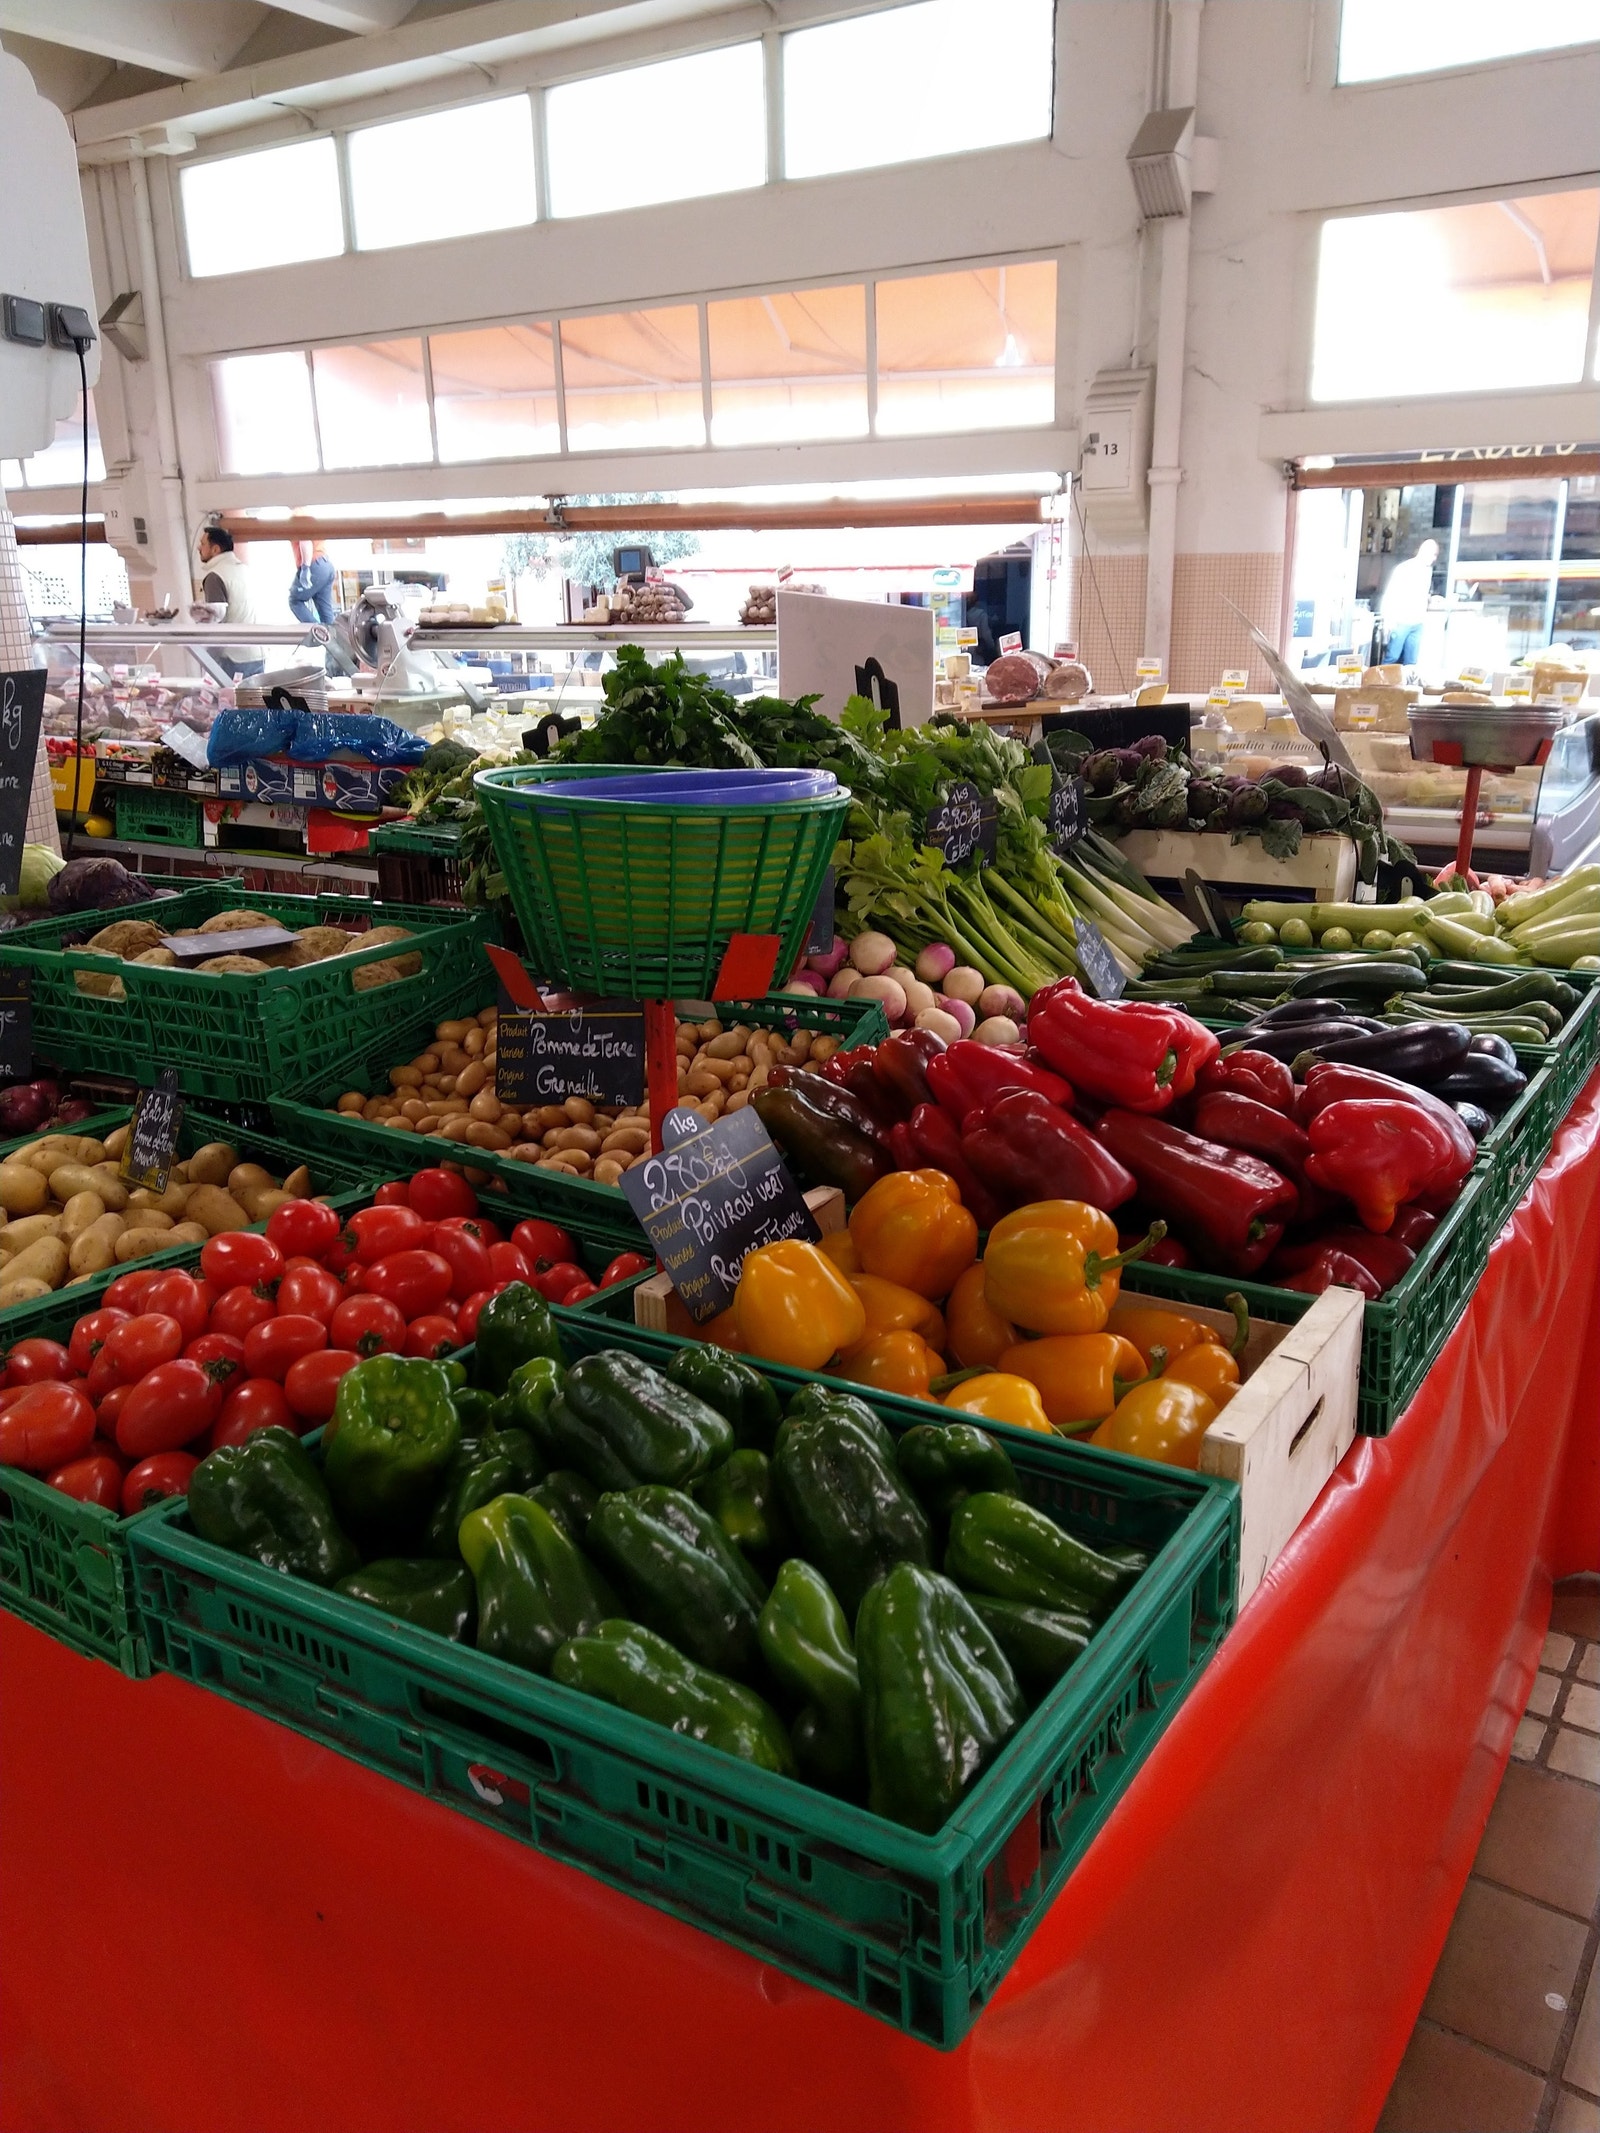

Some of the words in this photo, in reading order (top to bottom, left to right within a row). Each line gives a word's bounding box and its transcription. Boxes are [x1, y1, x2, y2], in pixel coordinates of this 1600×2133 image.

[1103, 443, 1118, 456] 13
[2, 677, 22, 750] kg
[1271, 740, 1316, 751] italiana
[952, 787, 969, 804] 1kg
[500, 1023, 528, 1039] Produit
[536, 1065, 603, 1097] Grenaille
[669, 1113, 698, 1136] 1kg
